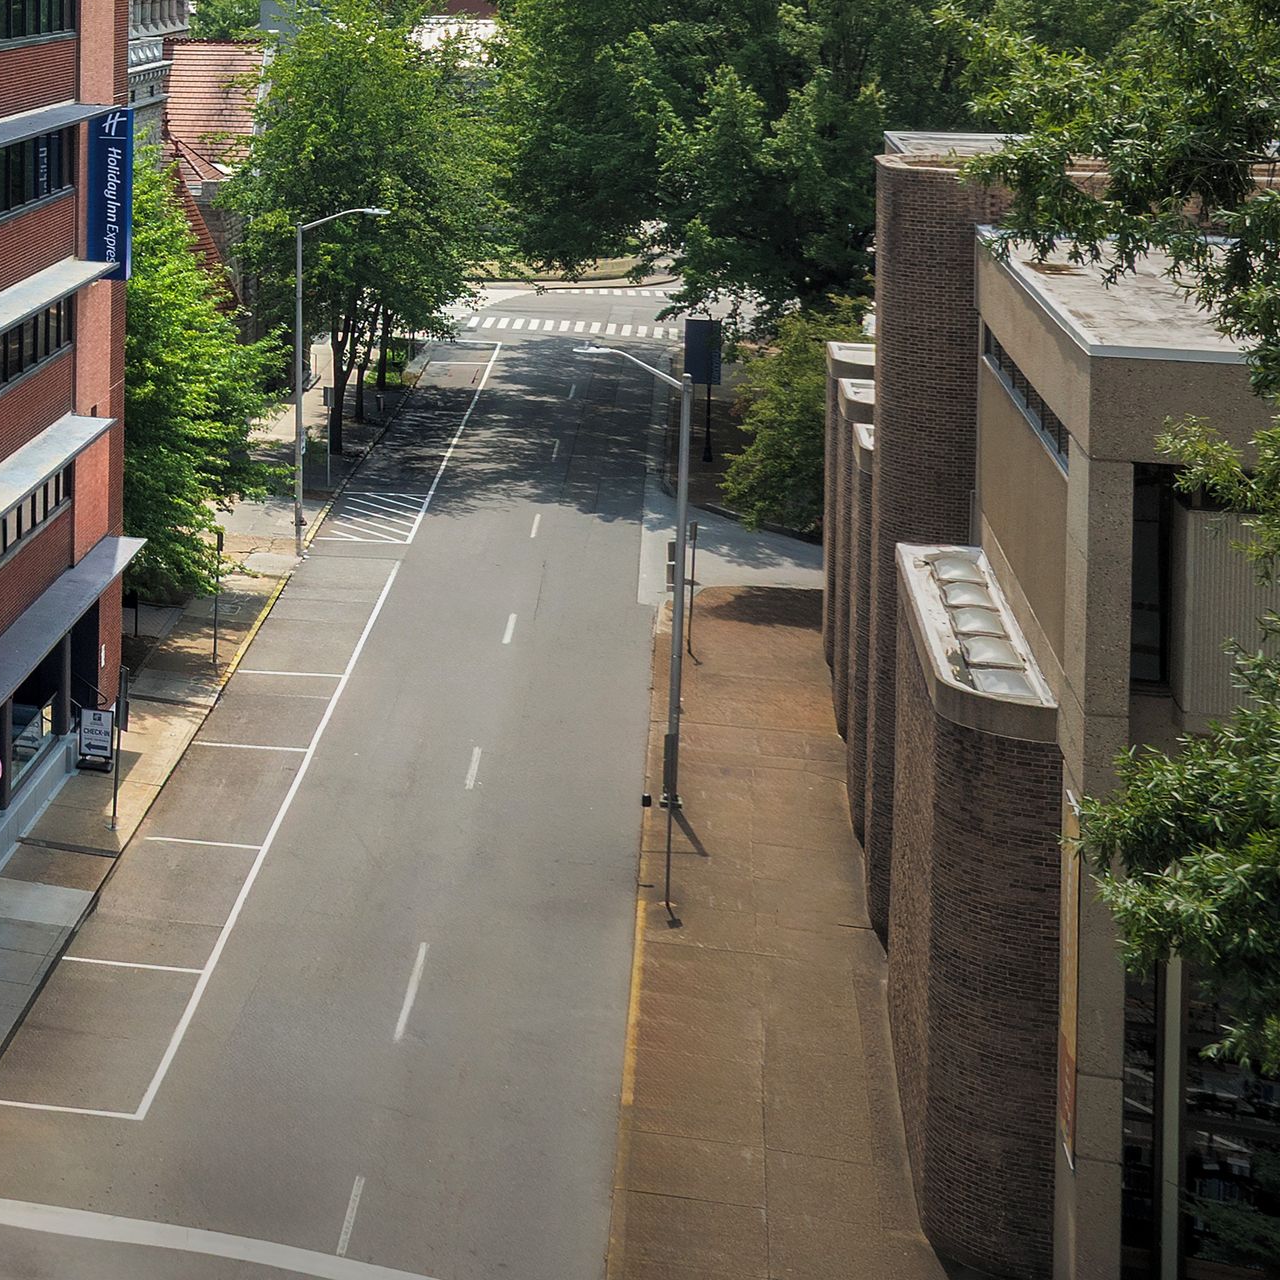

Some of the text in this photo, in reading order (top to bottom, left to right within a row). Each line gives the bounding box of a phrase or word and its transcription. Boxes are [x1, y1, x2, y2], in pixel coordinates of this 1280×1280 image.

[103, 146, 122, 200] Holiday
[106, 200, 122, 223] Inn
[83, 727, 110, 737] CHECK-IN
